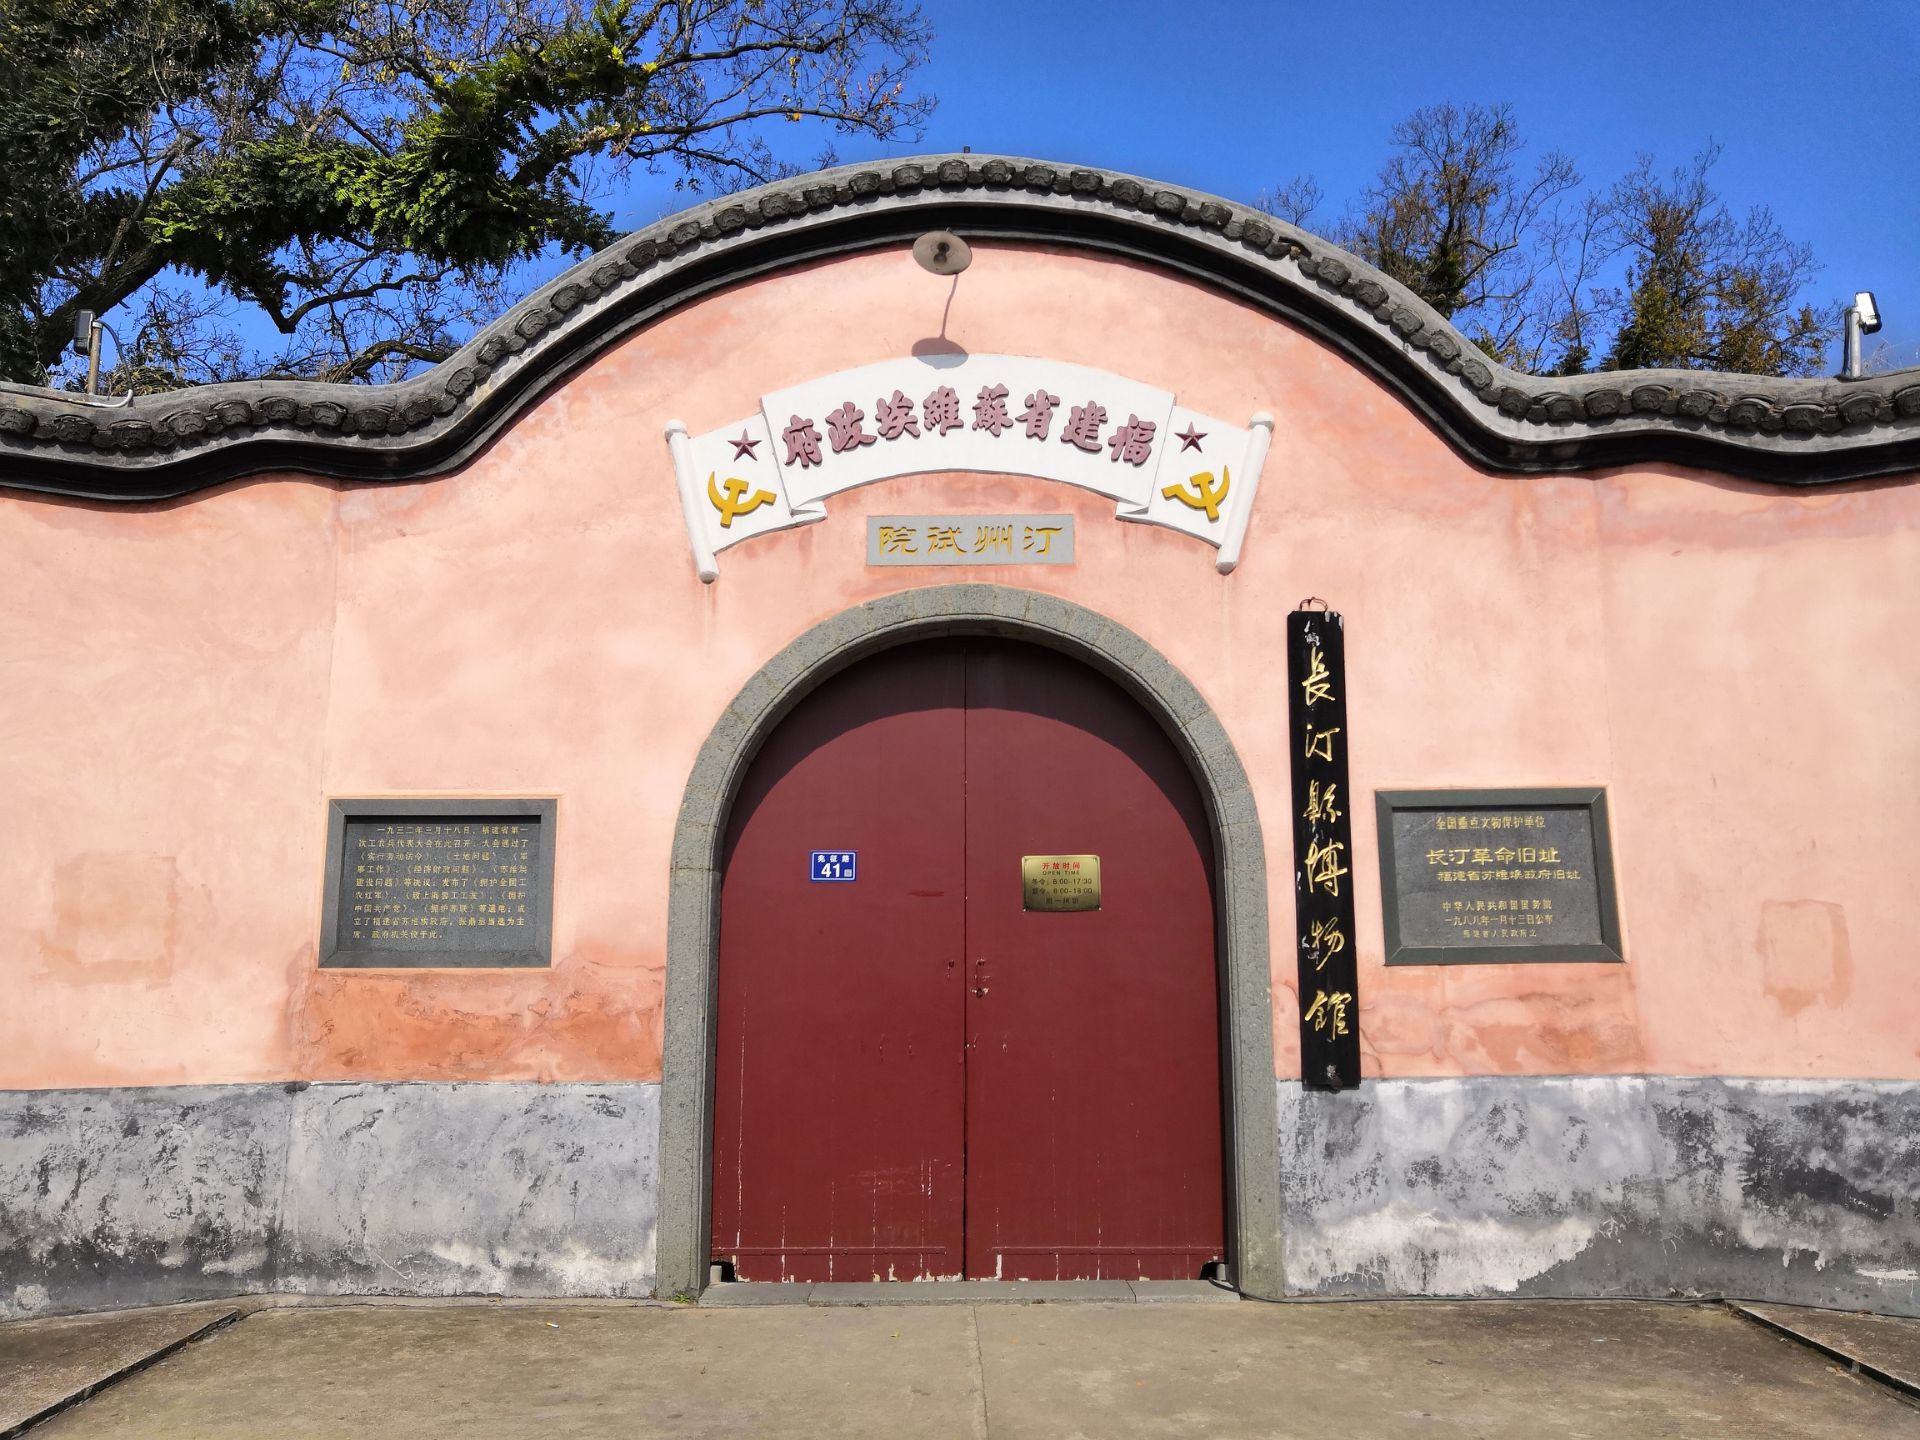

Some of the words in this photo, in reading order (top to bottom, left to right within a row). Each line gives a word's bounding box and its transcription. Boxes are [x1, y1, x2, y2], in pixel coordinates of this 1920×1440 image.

[1436, 815, 1546, 830] 全国重点文物保护单位
[1426, 847, 1561, 866] 长汀革命旧址
[821, 863, 840, 878] 41
[1042, 862, 1081, 870] 开放时间
[1436, 869, 1581, 882] 福建省苏维埃政府旧址
[1442, 898, 1552, 913] 中华人民共和国国务院
[1444, 914, 1553, 927] 一九八八年一月十三日公布
